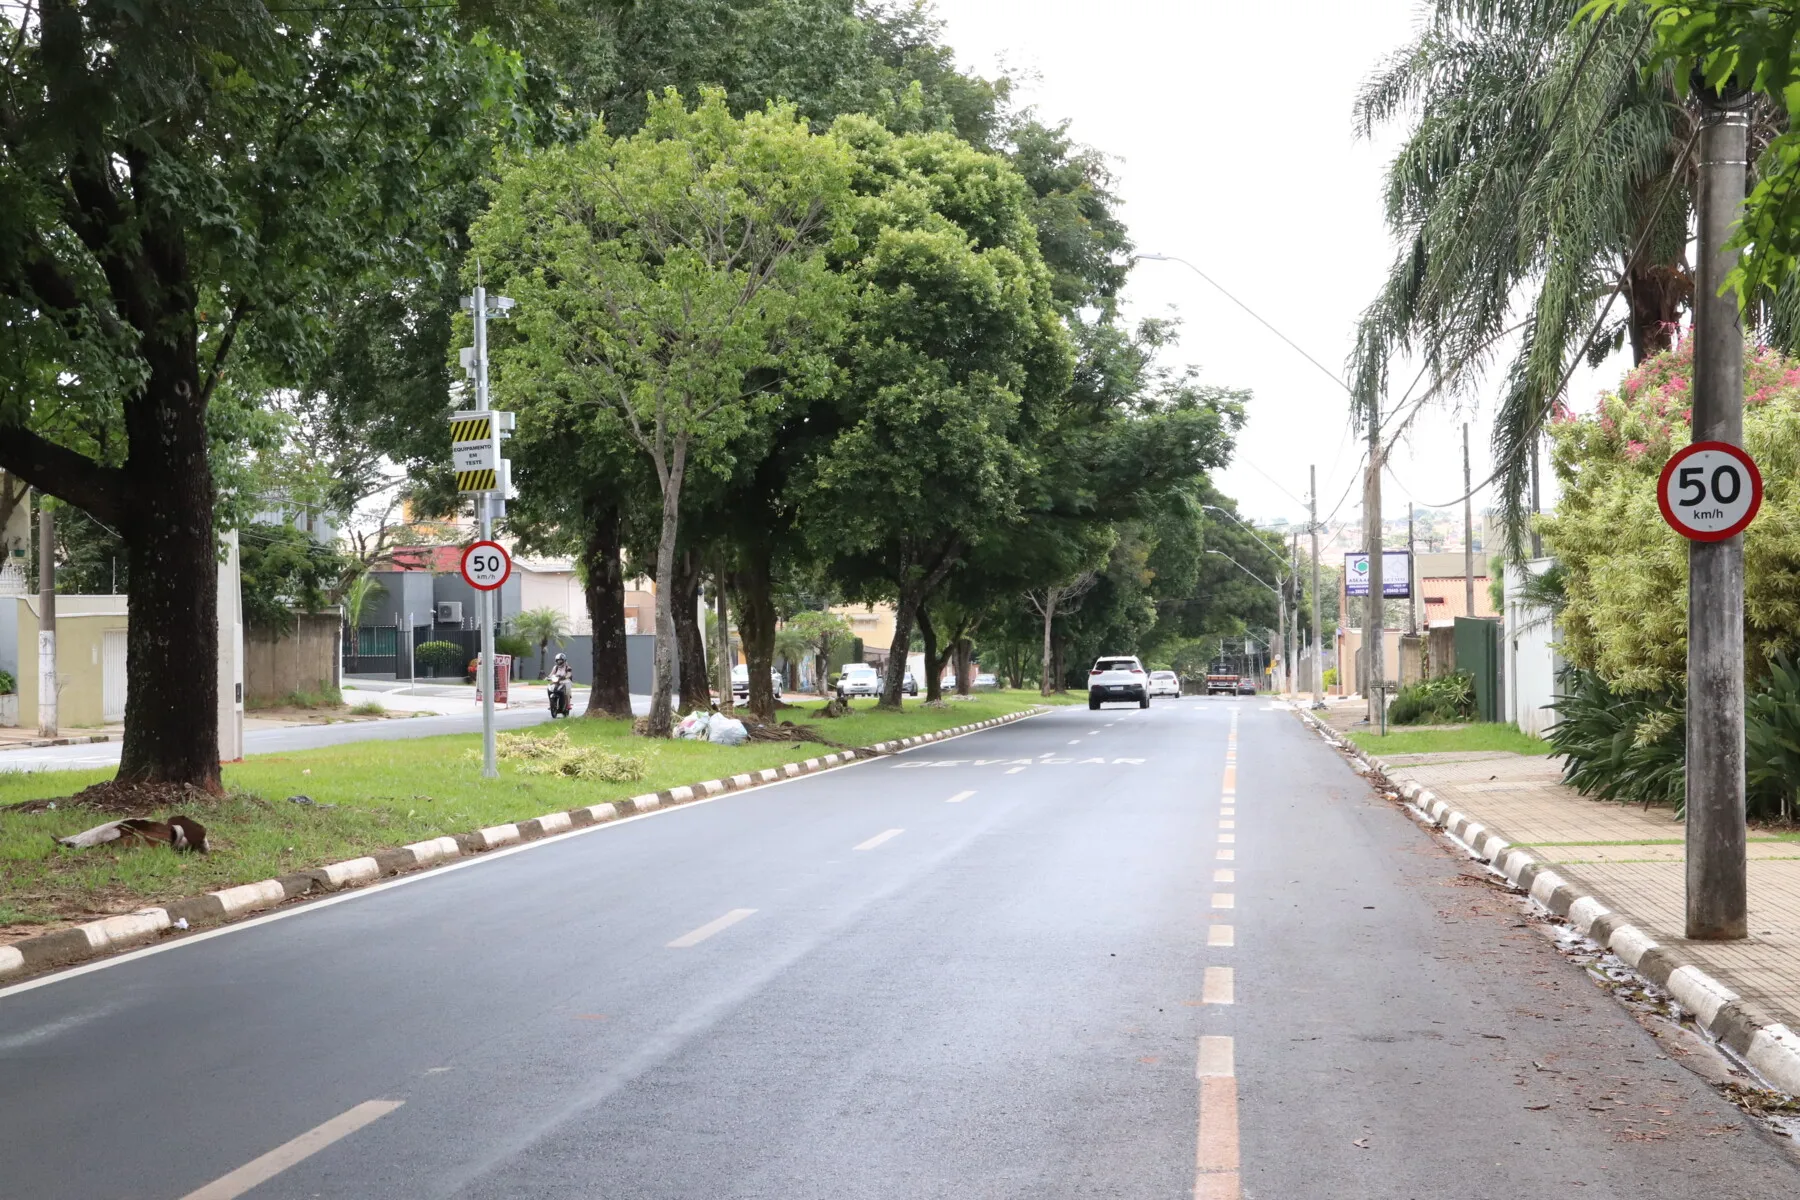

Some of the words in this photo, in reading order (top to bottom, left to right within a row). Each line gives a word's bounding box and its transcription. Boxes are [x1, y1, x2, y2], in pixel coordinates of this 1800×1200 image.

[1679, 465, 1741, 507] 50
[1693, 508, 1724, 520] km/h
[473, 556, 500, 572] 50
